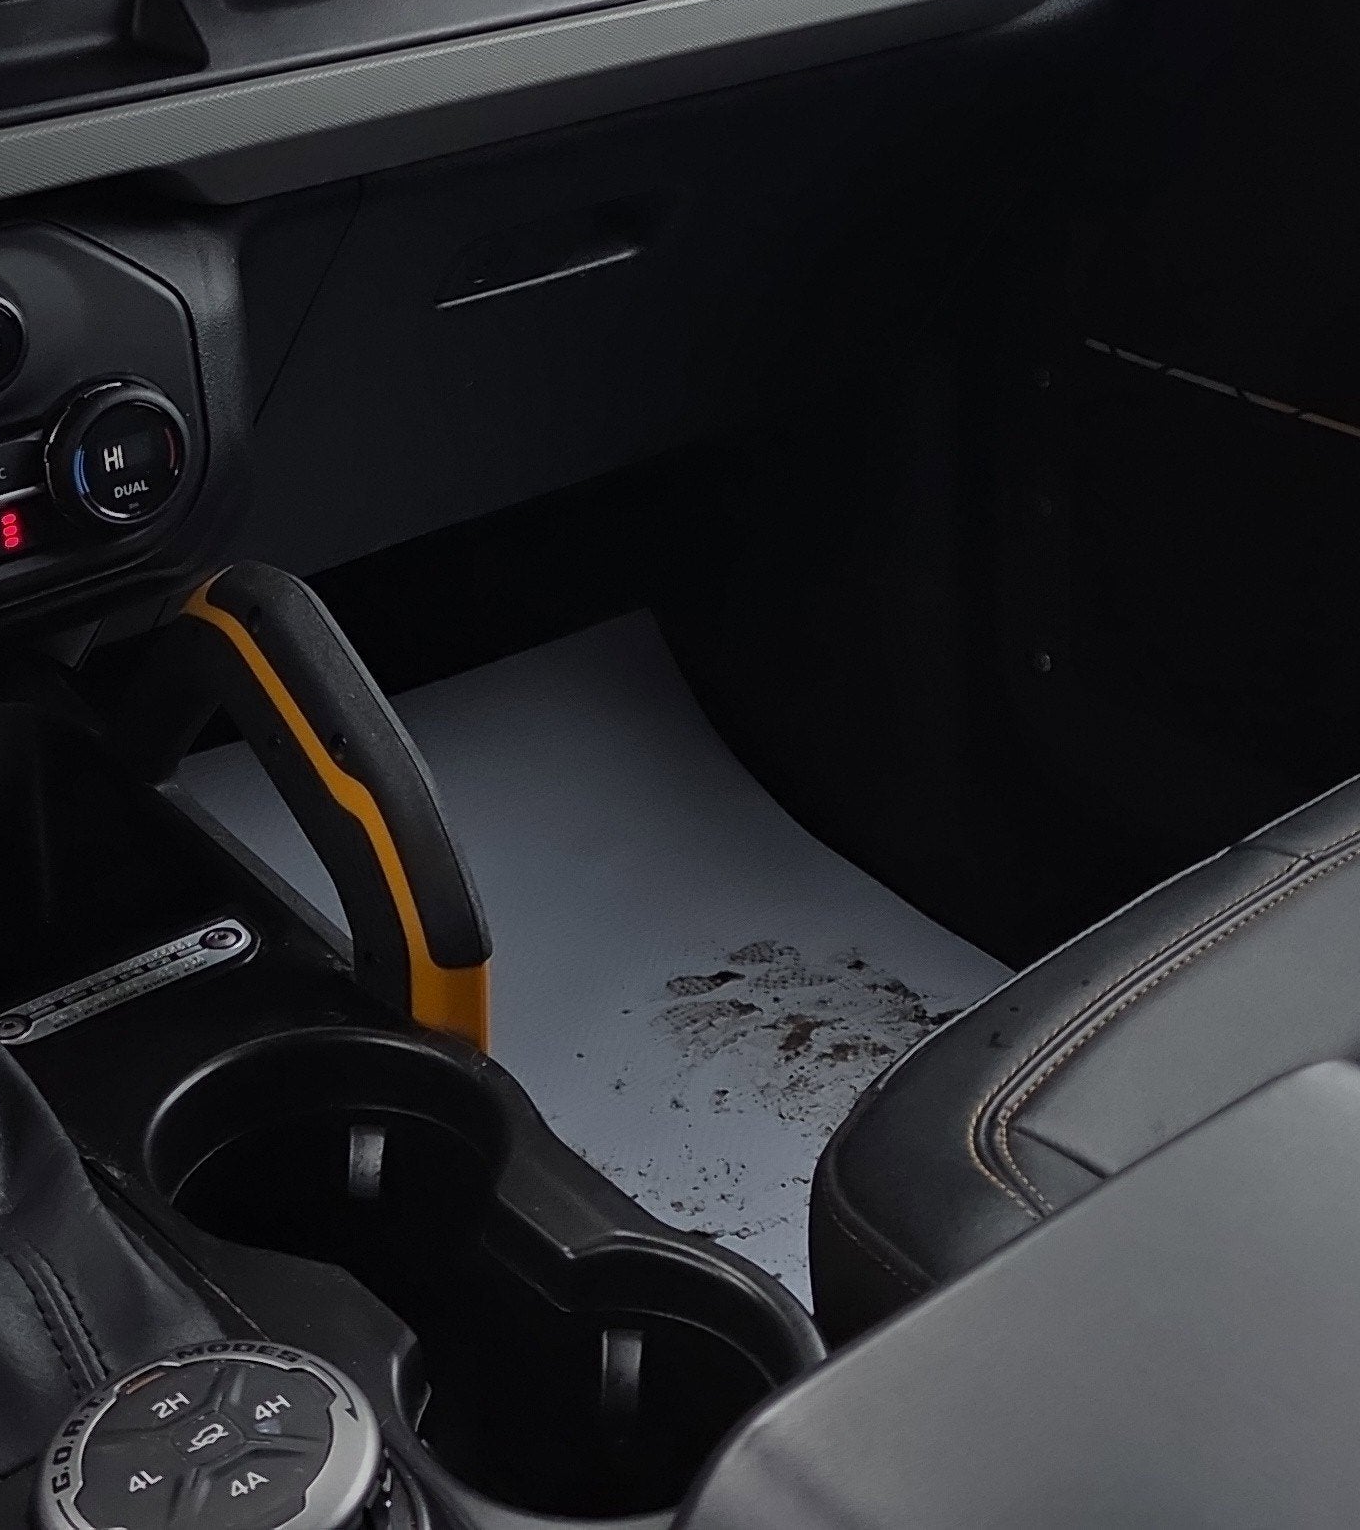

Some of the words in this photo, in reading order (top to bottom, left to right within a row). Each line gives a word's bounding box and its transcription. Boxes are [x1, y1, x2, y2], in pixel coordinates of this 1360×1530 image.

[103, 444, 125, 472] HI
[113, 479, 150, 499] DUAL
[176, 1341, 303, 1364] MODES
[150, 1391, 191, 1419] 2H
[254, 1394, 291, 1421] 4H
[128, 1470, 164, 1493] 4L
[229, 1471, 270, 1498] 4A
